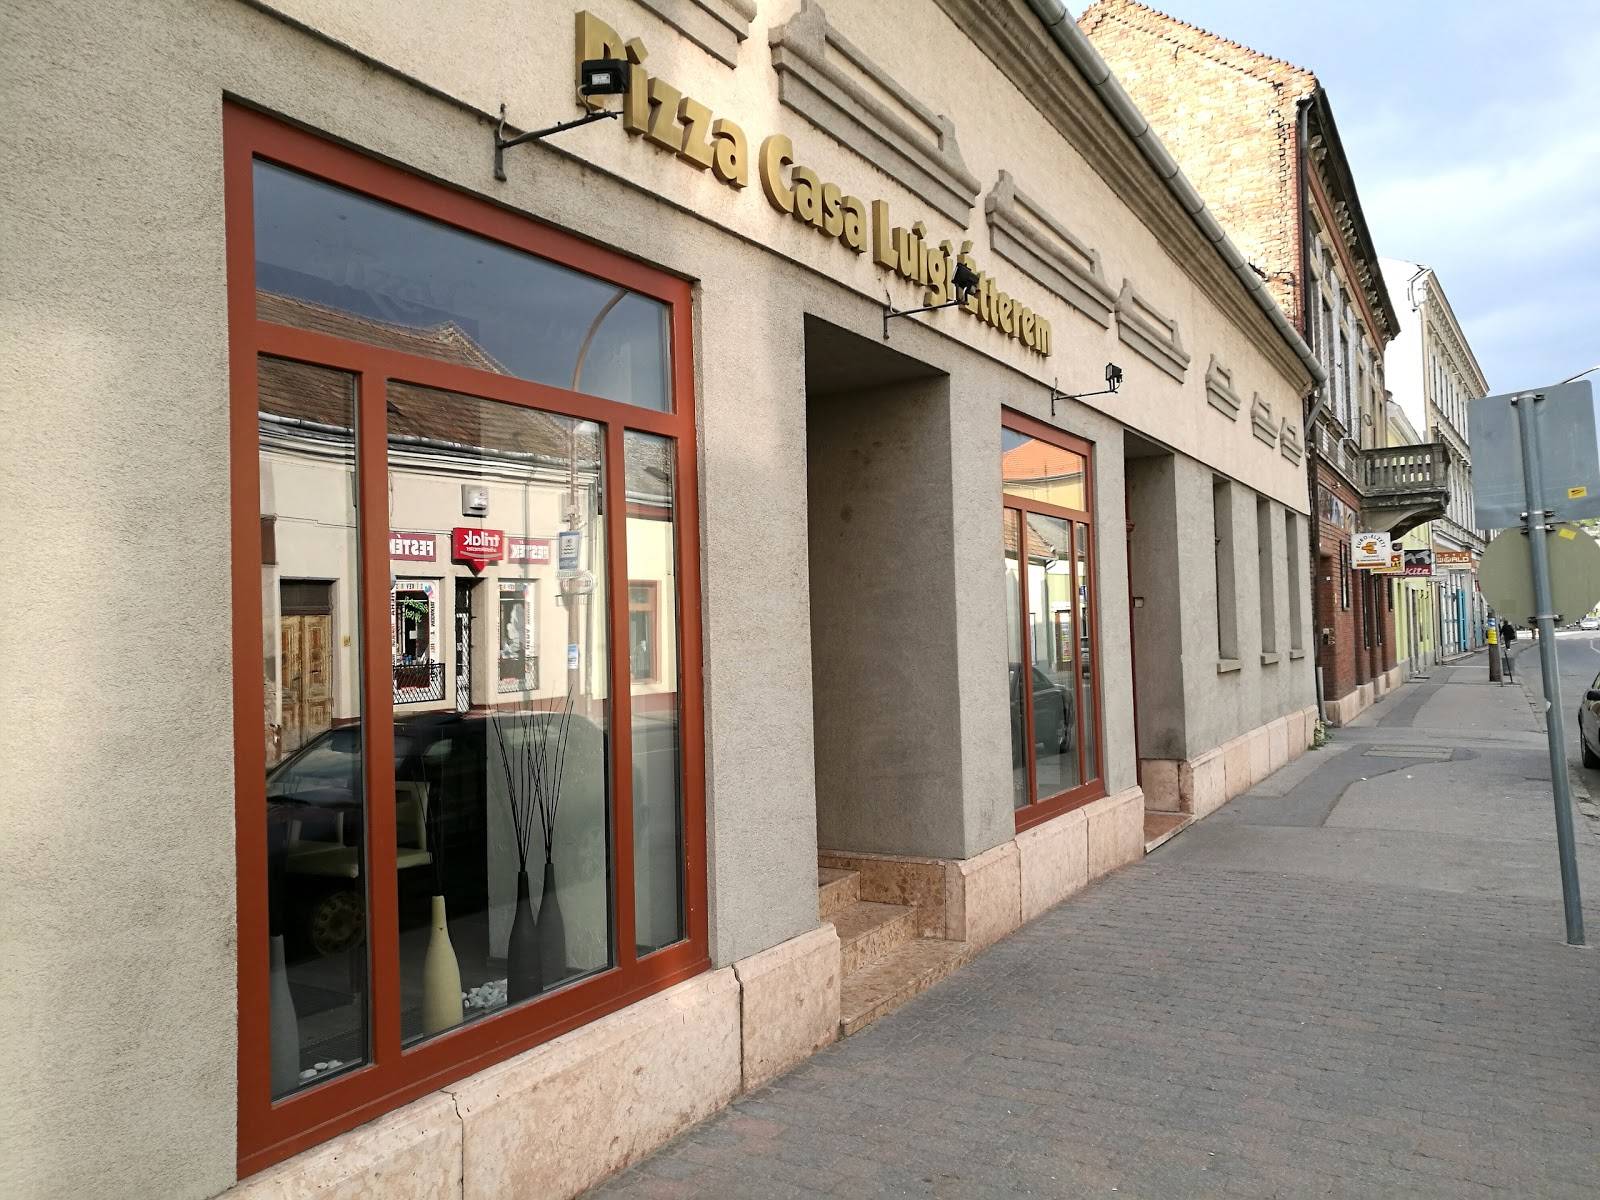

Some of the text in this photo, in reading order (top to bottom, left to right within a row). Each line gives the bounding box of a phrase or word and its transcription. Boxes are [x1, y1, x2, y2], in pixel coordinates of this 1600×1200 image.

[575, 10, 748, 189] Pizza
[759, 134, 866, 254] Casa
[872, 199, 956, 307] Luigi
